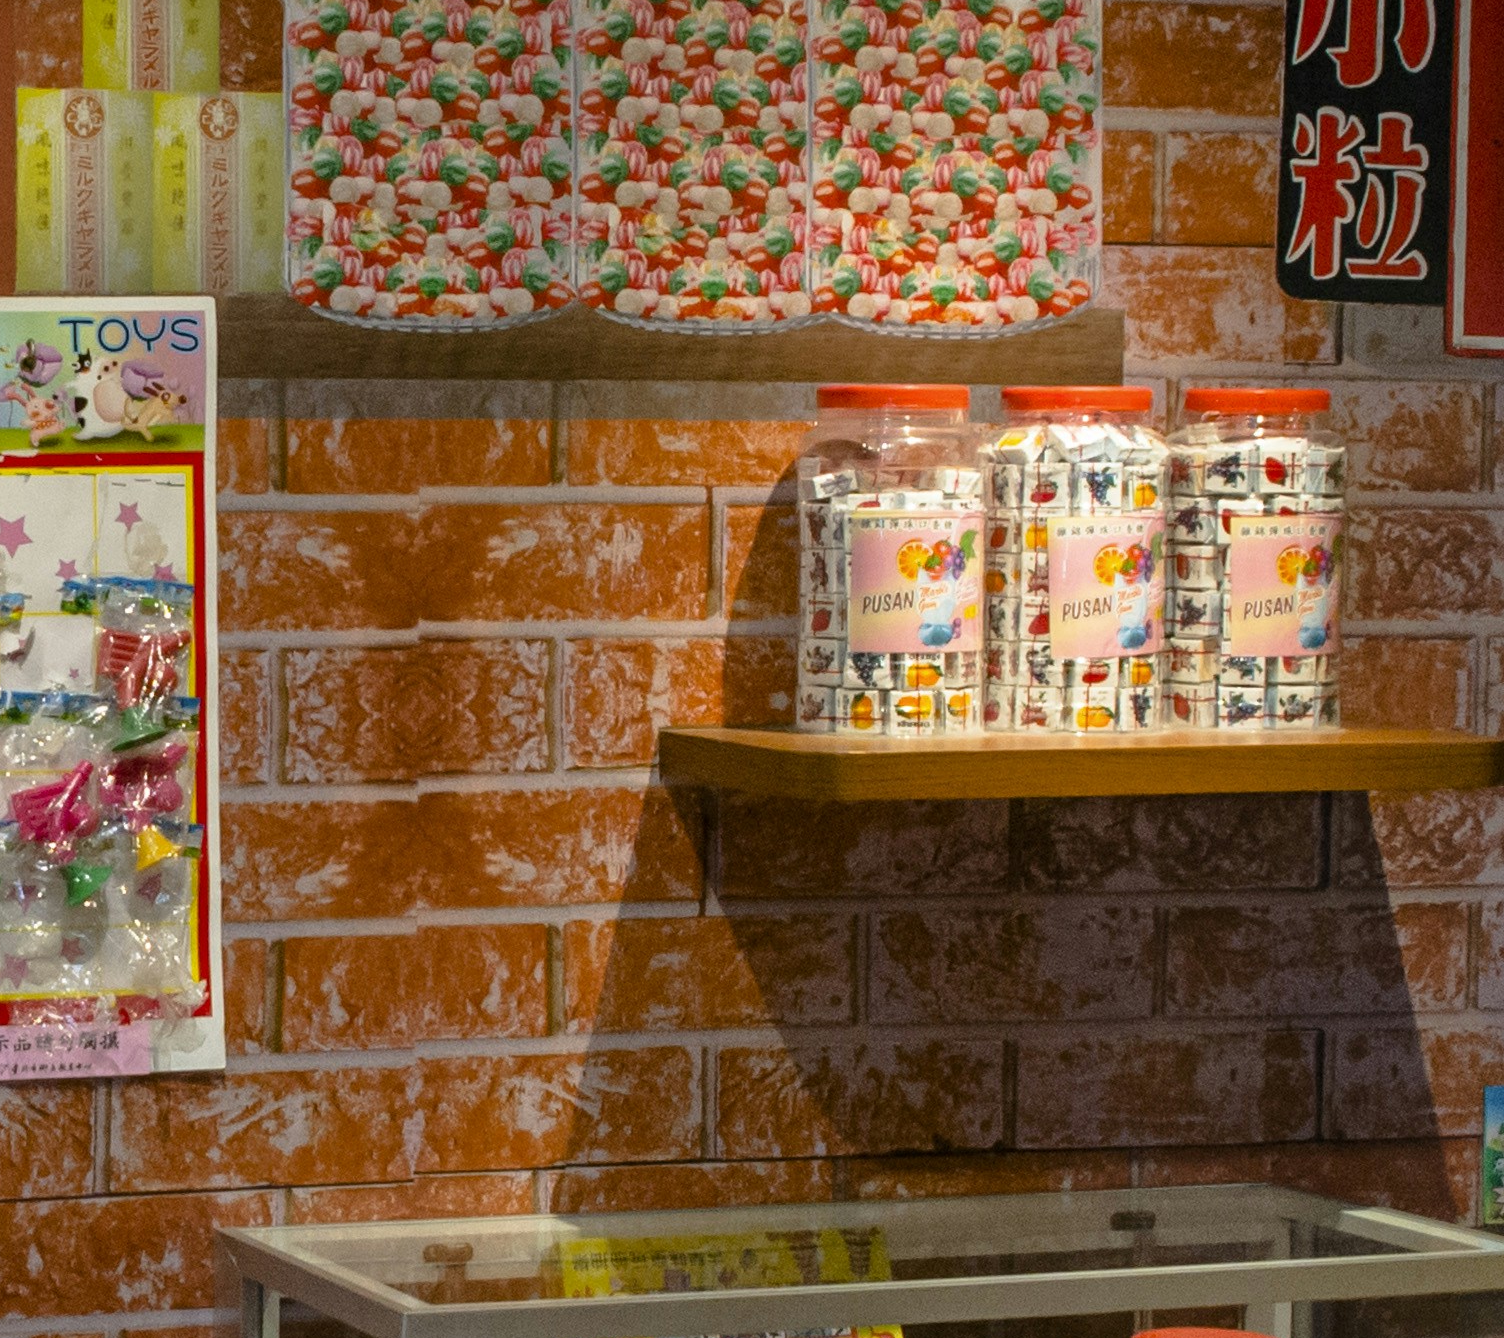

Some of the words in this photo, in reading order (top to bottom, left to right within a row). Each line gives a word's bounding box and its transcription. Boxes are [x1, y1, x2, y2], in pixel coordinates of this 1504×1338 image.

[58, 315, 200, 357] TOYS
[862, 590, 915, 614] PUSAN
[1062, 595, 1113, 622] PUSAN
[1244, 595, 1294, 620] PUSAN
